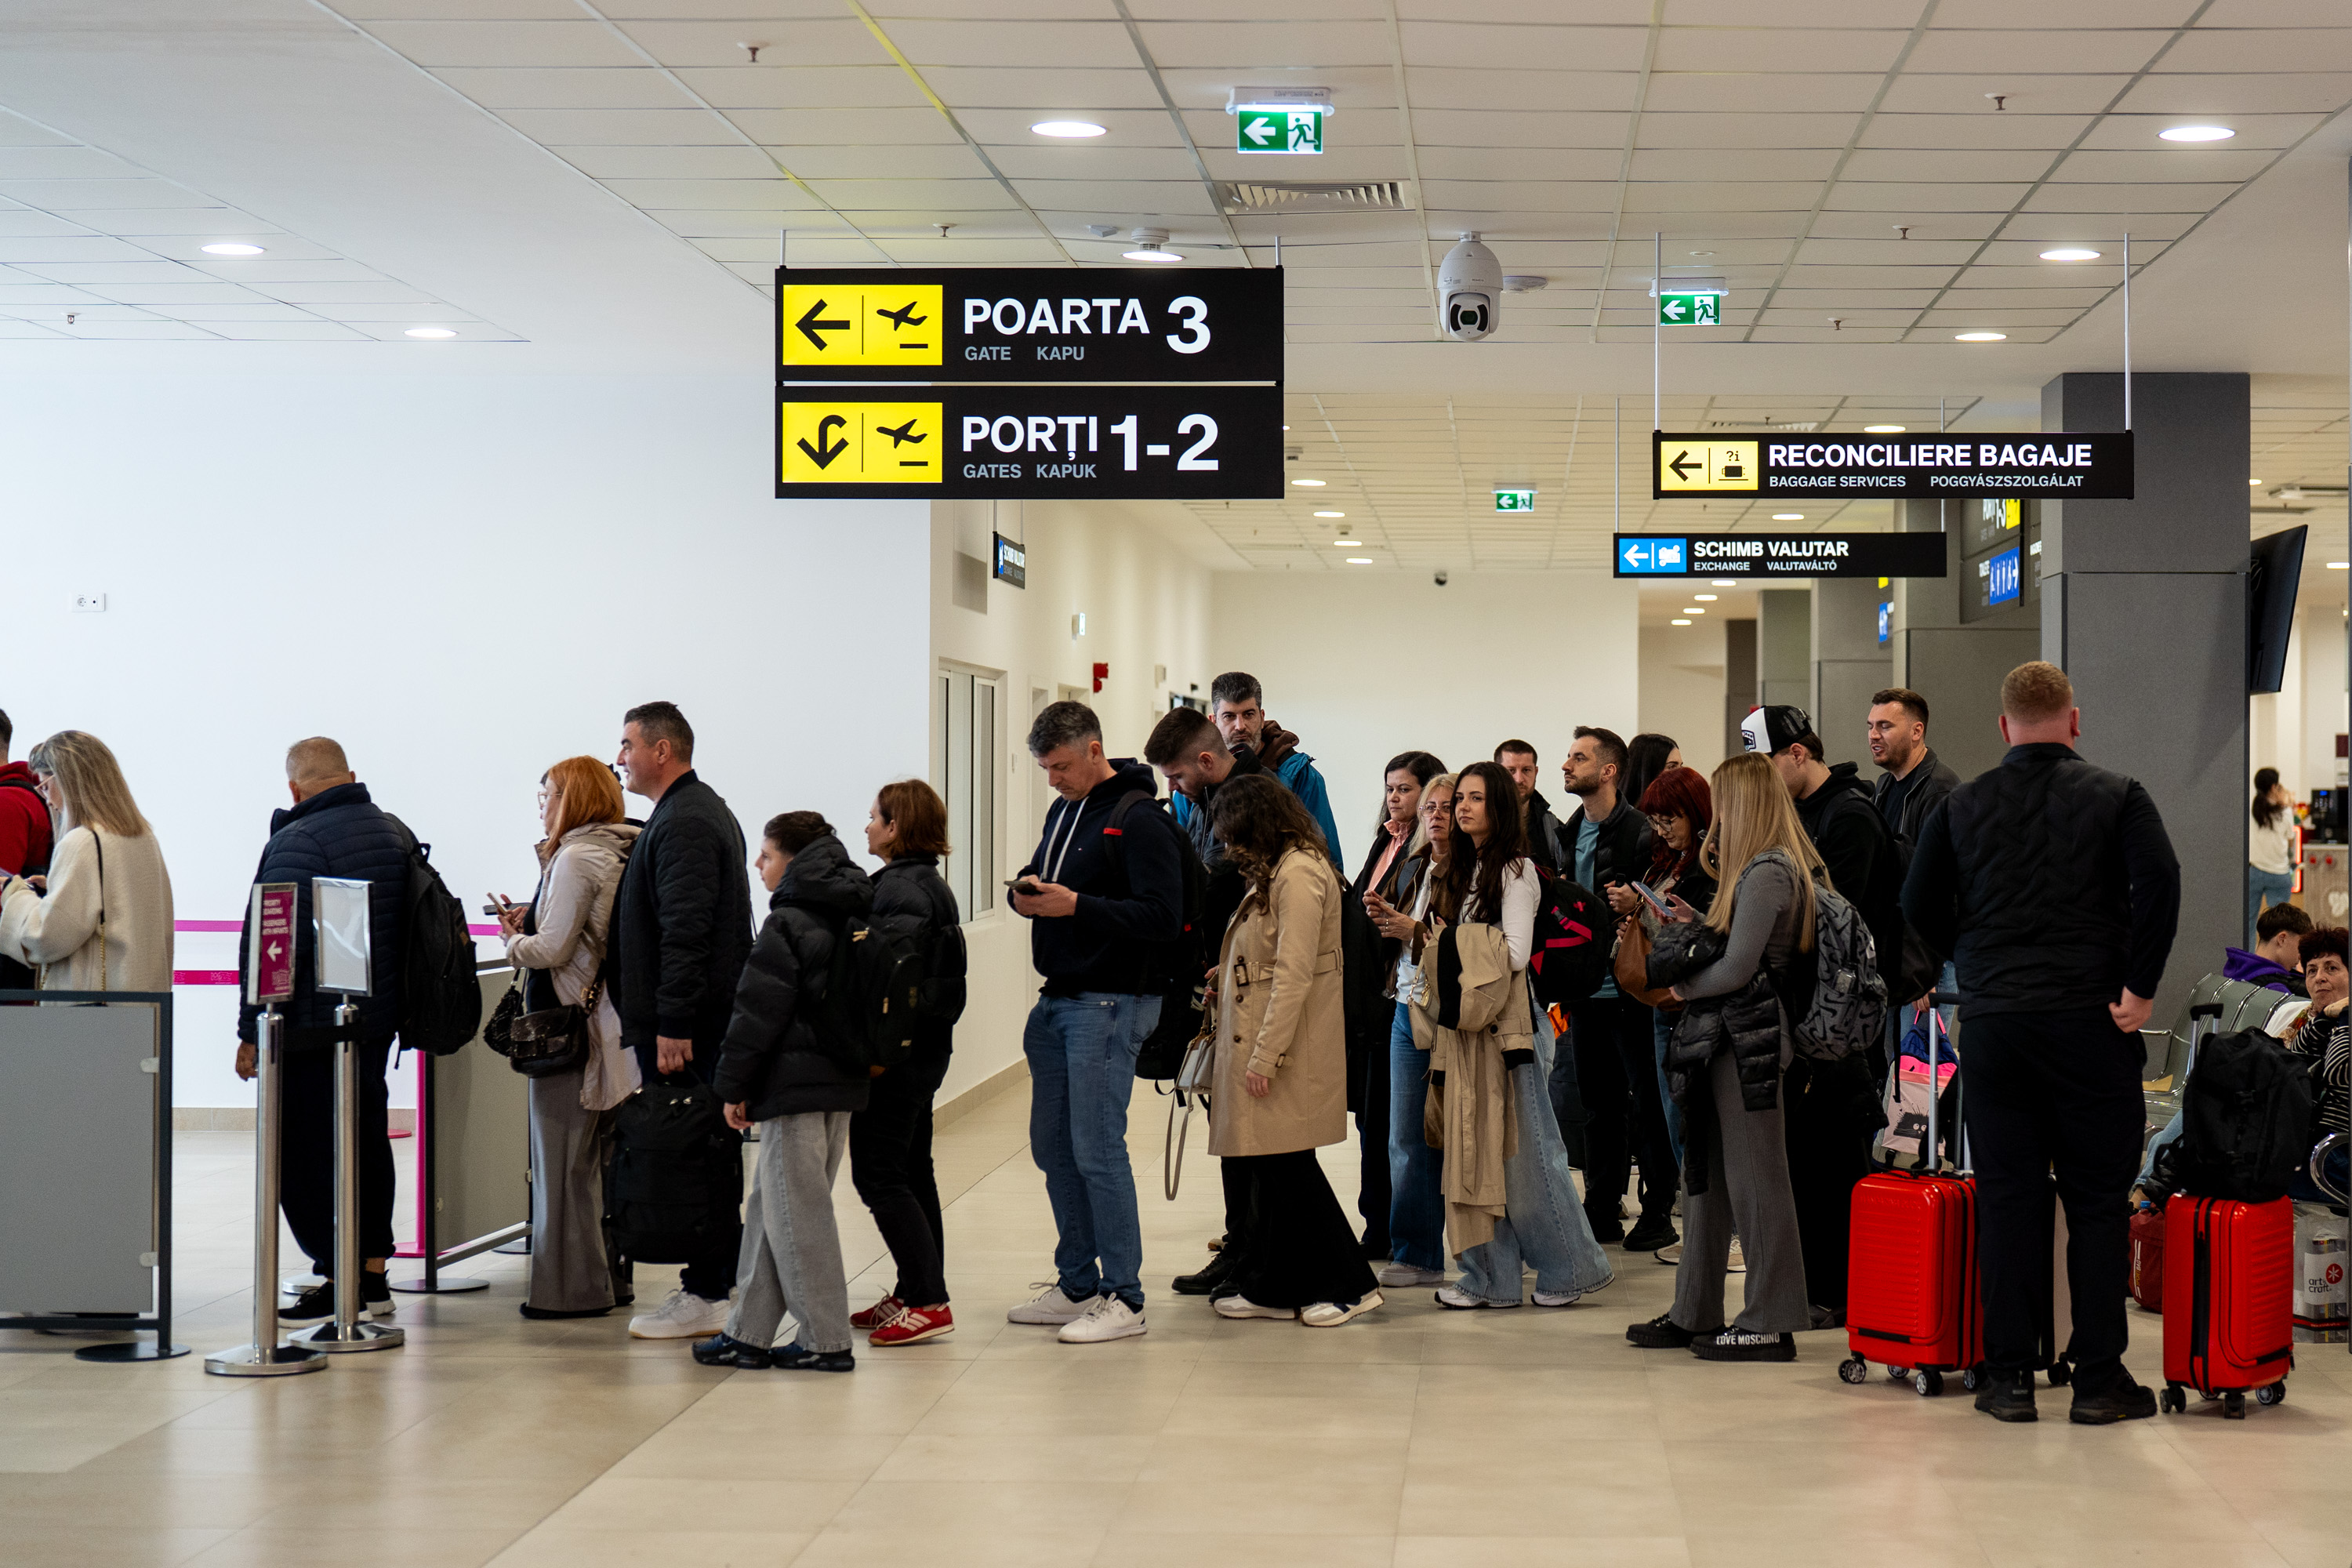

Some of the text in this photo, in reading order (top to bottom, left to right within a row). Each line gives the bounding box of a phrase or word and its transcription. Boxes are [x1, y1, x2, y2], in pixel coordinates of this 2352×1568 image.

[964, 296, 1211, 355] POARTA 3
[964, 346, 1085, 361] GATE KAPU
[1110, 413, 1219, 471] 1-2
[1769, 444, 2092, 467] RECONCILIERE BAGAJE
[963, 463, 1098, 478] GATES KAPUK
[1769, 473, 2084, 488] BAGGAGE SERVICES POGGYÁSZSZOLGÁLAT
[1693, 541, 1849, 557] SCHIMB VALUTAR
[1694, 559, 1838, 571] EXCHANGE VALUTAVÁLTÓ
[2308, 1277, 2323, 1287] art
[2308, 1283, 2329, 1294] craft
[1715, 1332, 1780, 1345] LOVE MOSCHINO
